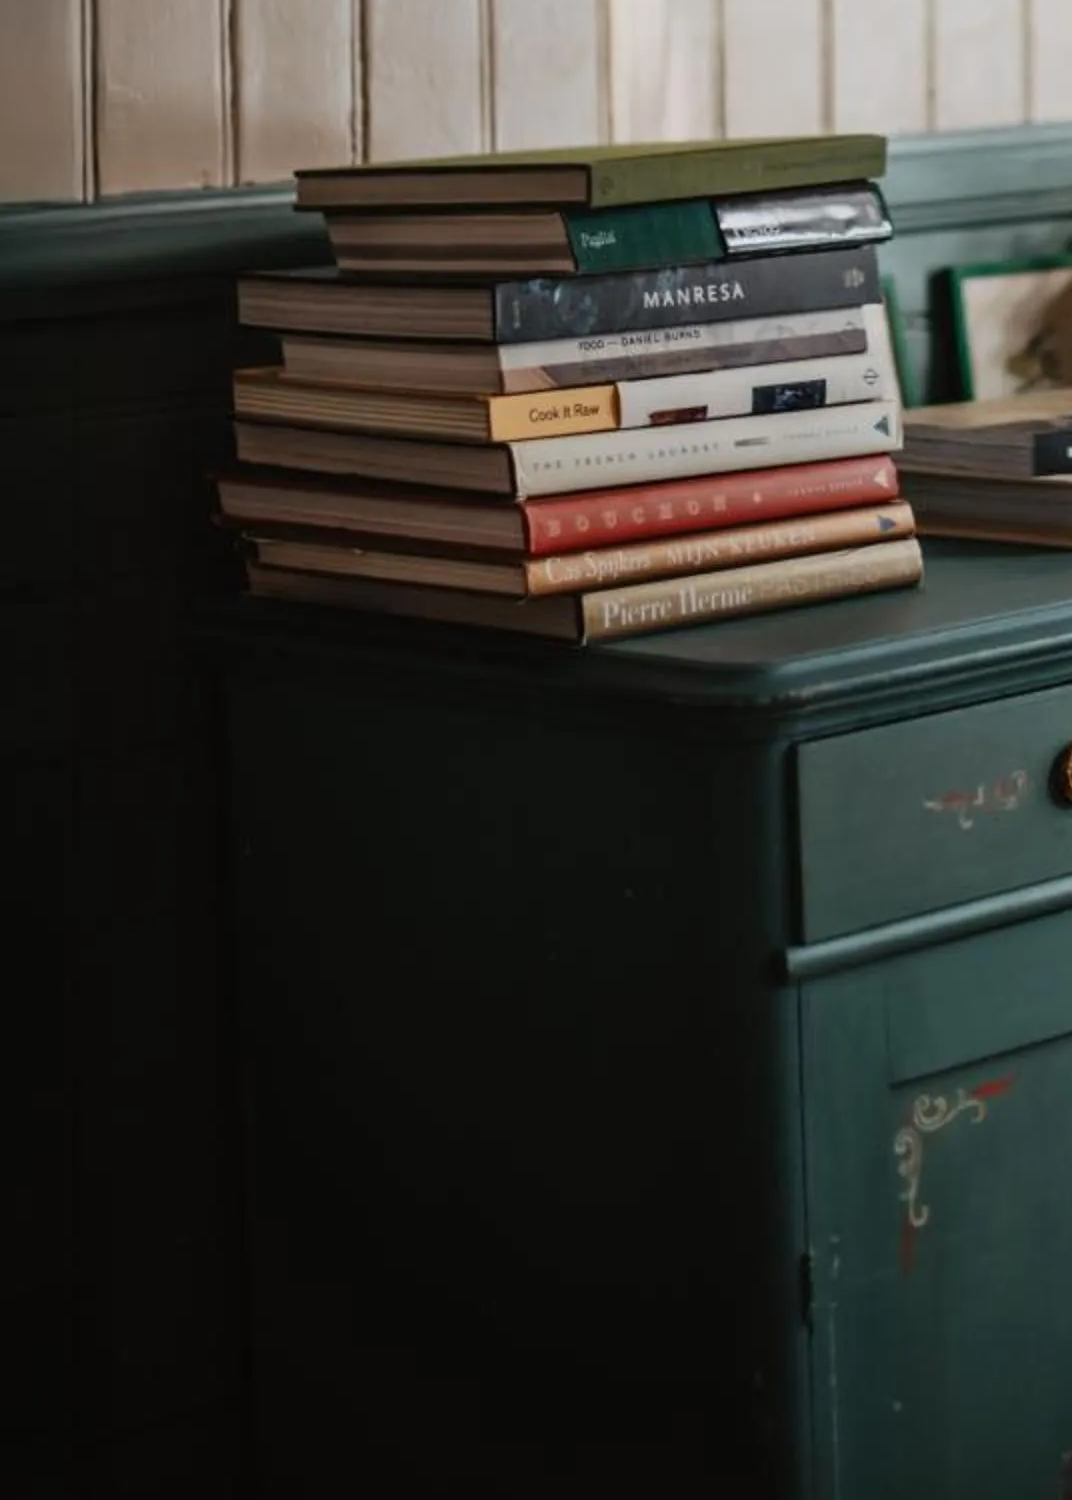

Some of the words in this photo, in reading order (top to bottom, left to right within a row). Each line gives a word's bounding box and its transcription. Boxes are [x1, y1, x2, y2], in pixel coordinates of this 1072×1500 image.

[643, 282, 746, 309] MANRESA
[577, 339, 605, 351] FOOD
[621, 334, 660, 348] DANIEL
[528, 407, 559, 423] Cook
[562, 405, 571, 419] It
[573, 403, 600, 418] Raw
[532, 460, 563, 472] THE
[603, 596, 673, 629] Pierre
